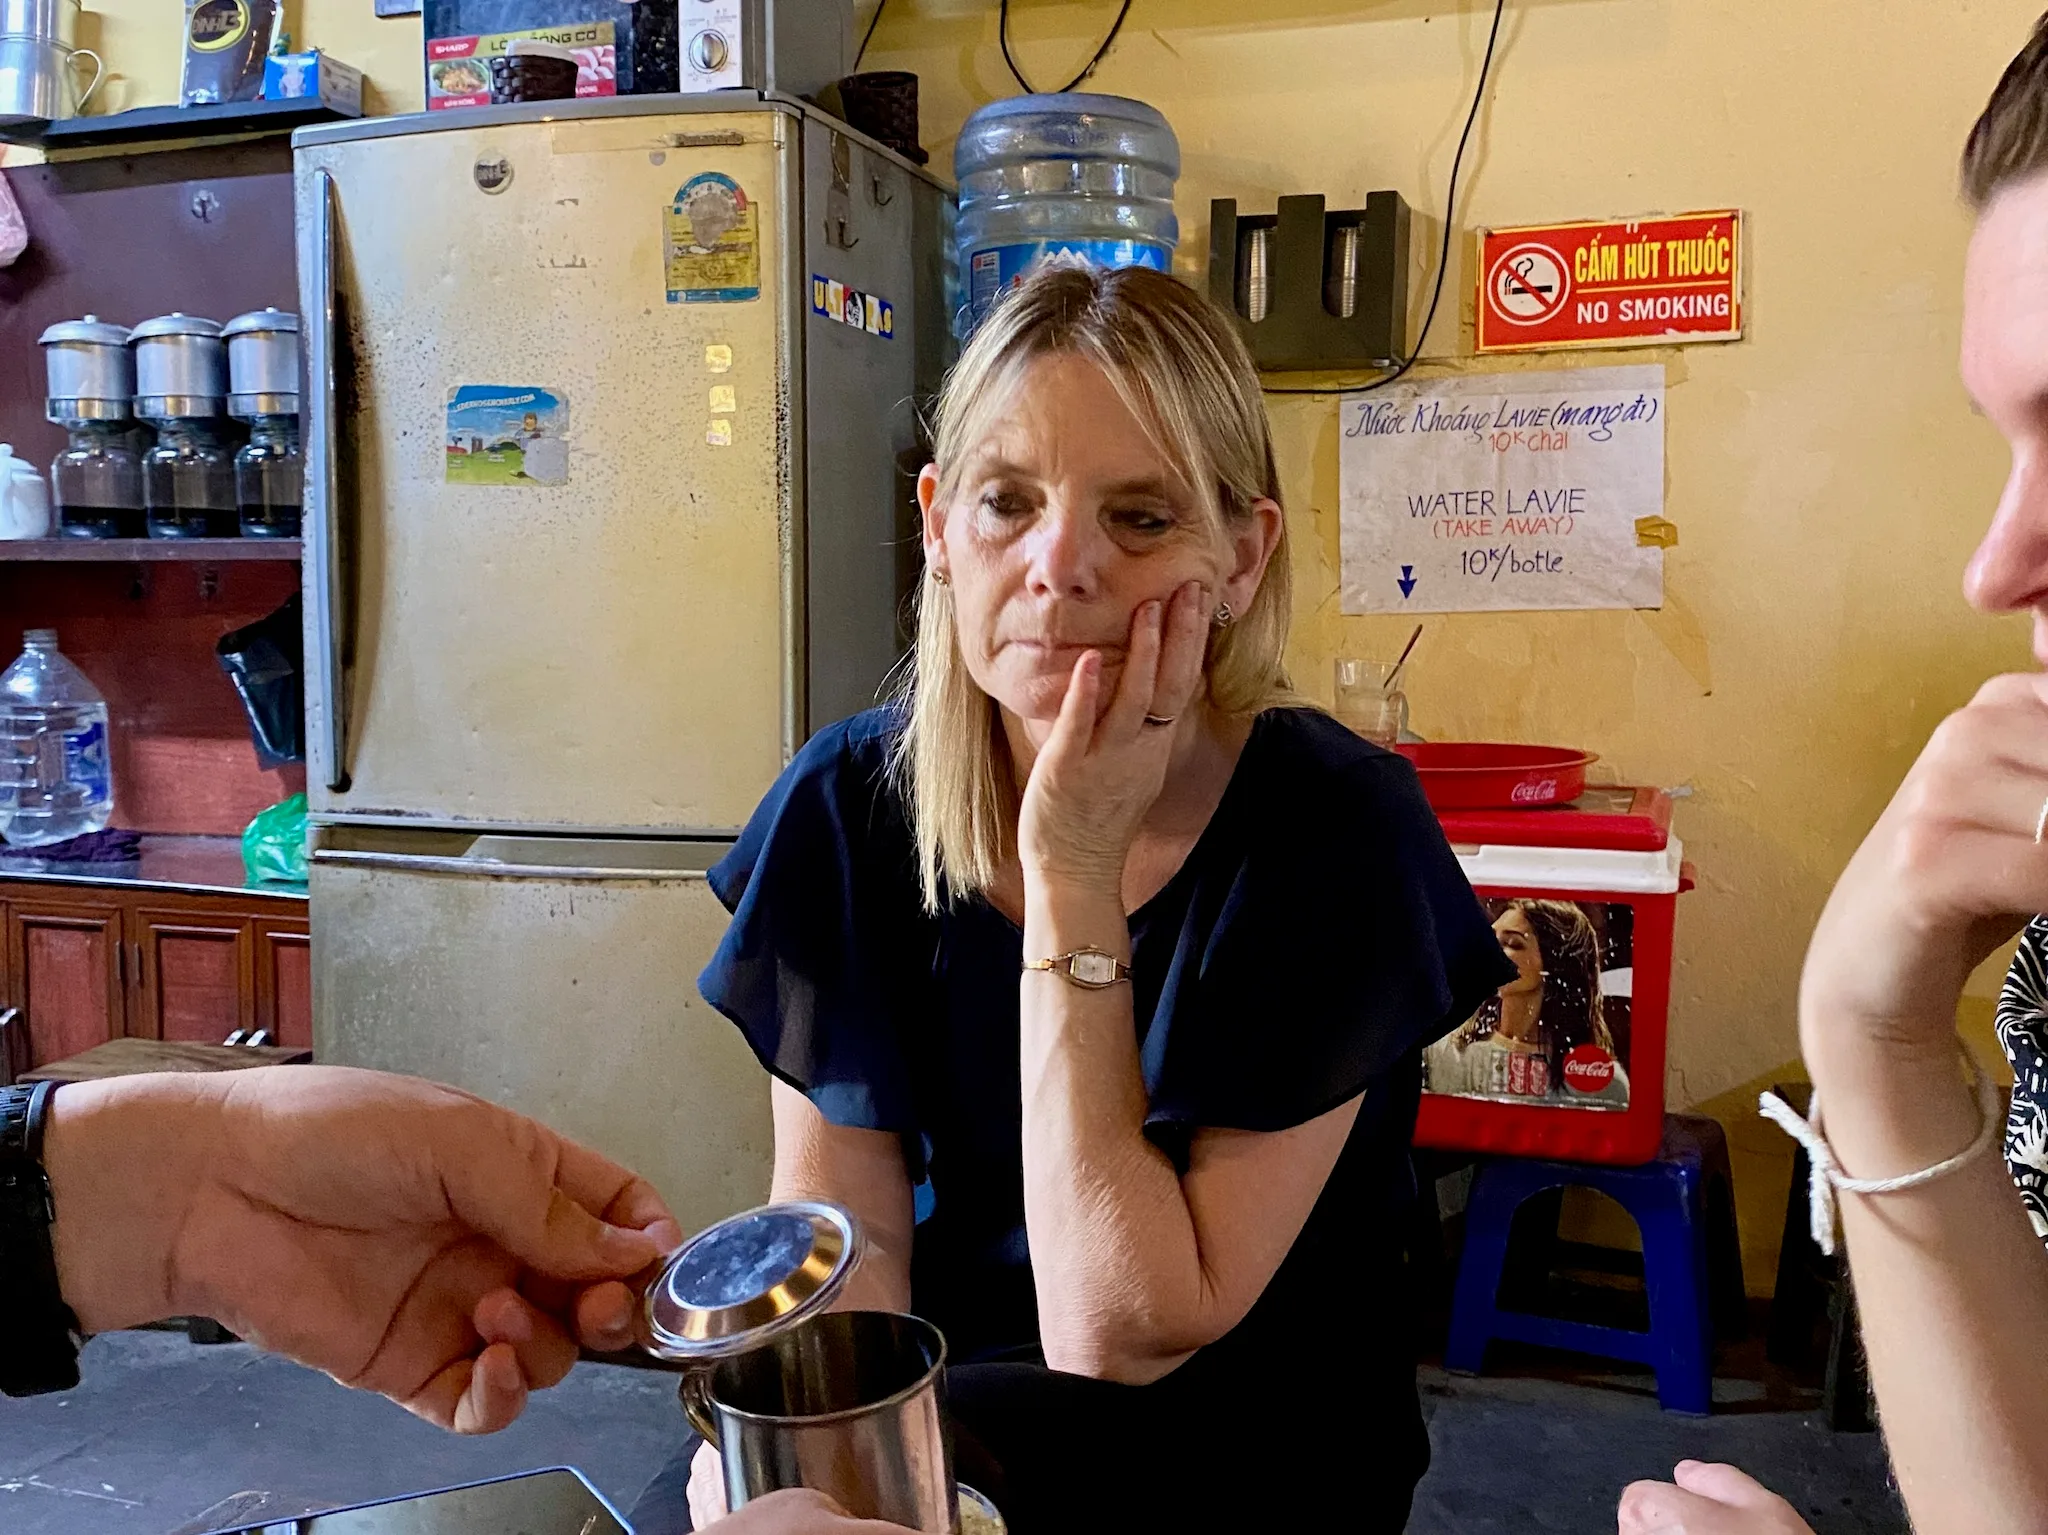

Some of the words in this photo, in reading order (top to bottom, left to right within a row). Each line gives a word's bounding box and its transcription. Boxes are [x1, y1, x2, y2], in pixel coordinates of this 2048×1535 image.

[435, 42, 470, 55] SHARP
[1575, 232, 1619, 283] CẤM
[1624, 234, 1662, 280] HÚT
[1666, 224, 1730, 277] THUỐC
[1577, 301, 1609, 324] NO
[1618, 293, 1730, 322] SMOKING
[1411, 400, 1490, 444] Khoáng
[1527, 429, 1569, 452] chai
[1408, 490, 1497, 518] WATER
[1507, 488, 1587, 514] LAVIE
[1433, 519, 1494, 539] (TAKE
[1501, 516, 1574, 536] AWAY)
